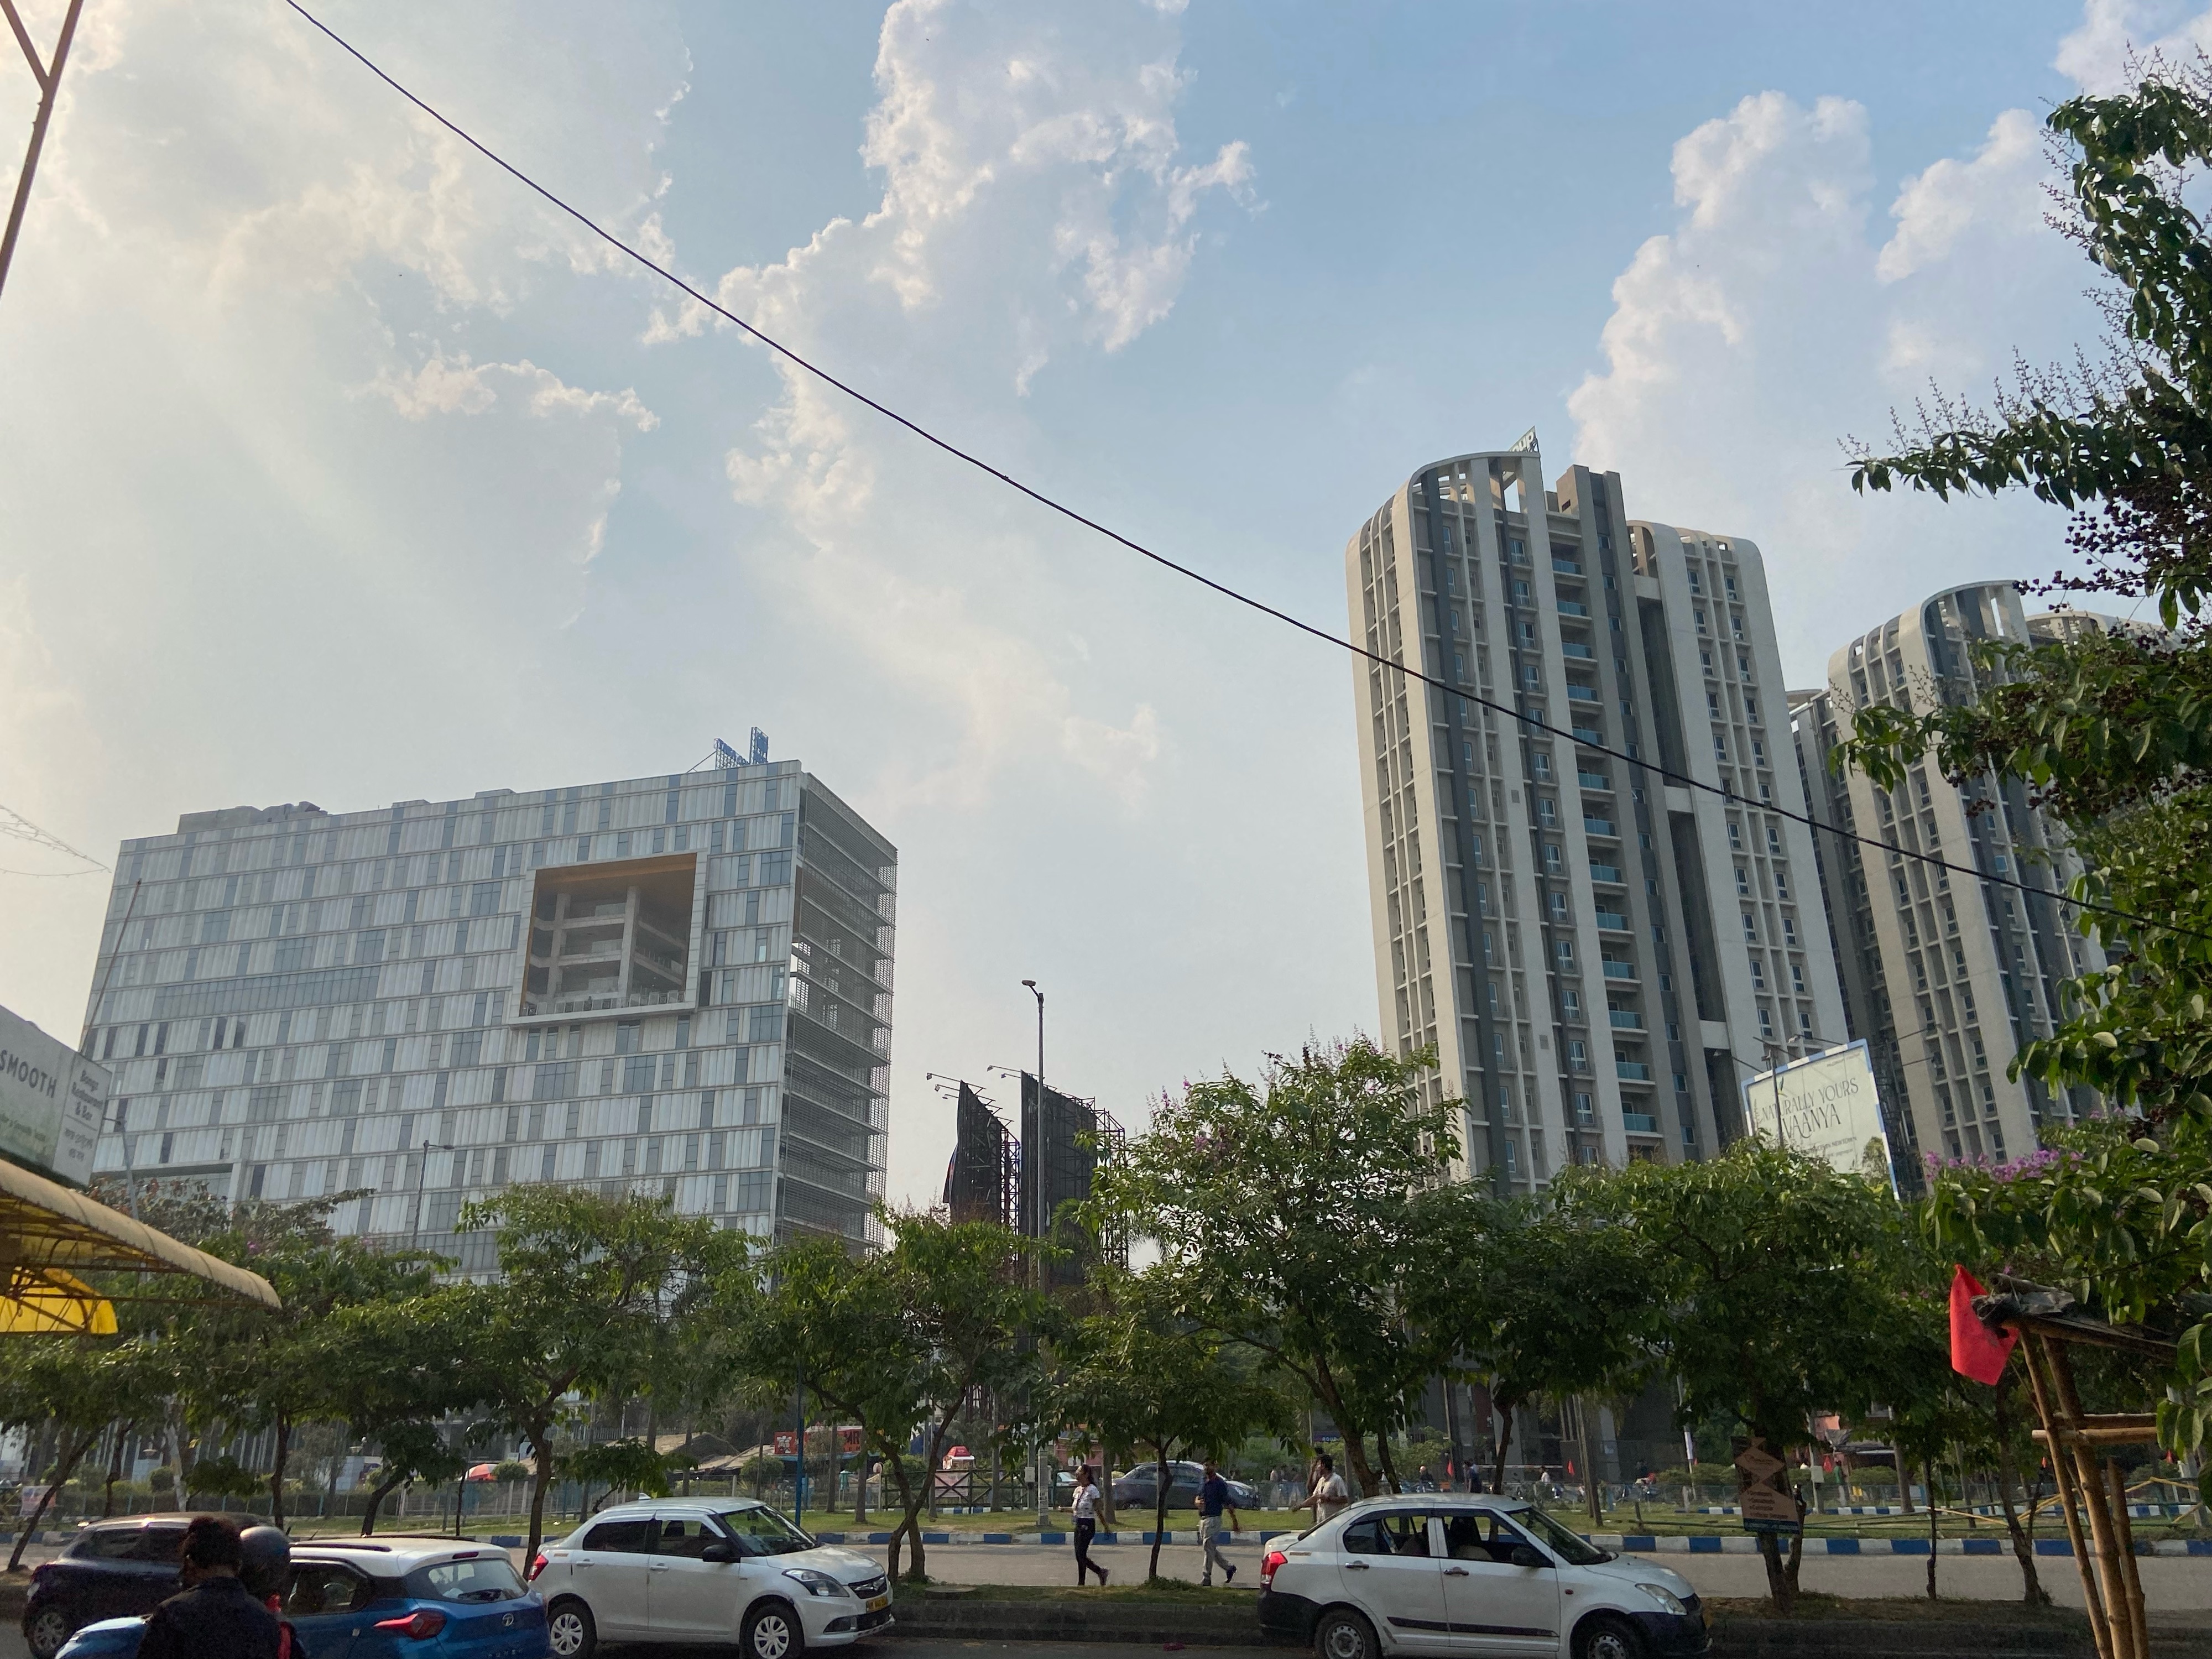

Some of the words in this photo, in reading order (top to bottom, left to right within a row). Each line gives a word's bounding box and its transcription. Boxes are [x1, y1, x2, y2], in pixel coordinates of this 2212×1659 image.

[1509, 431, 1533, 452] oup
[0, 1050, 57, 1098] SMOOTH
[1818, 1078, 1859, 1104] YOURS
[1782, 1103, 1841, 1139] VAANYA
